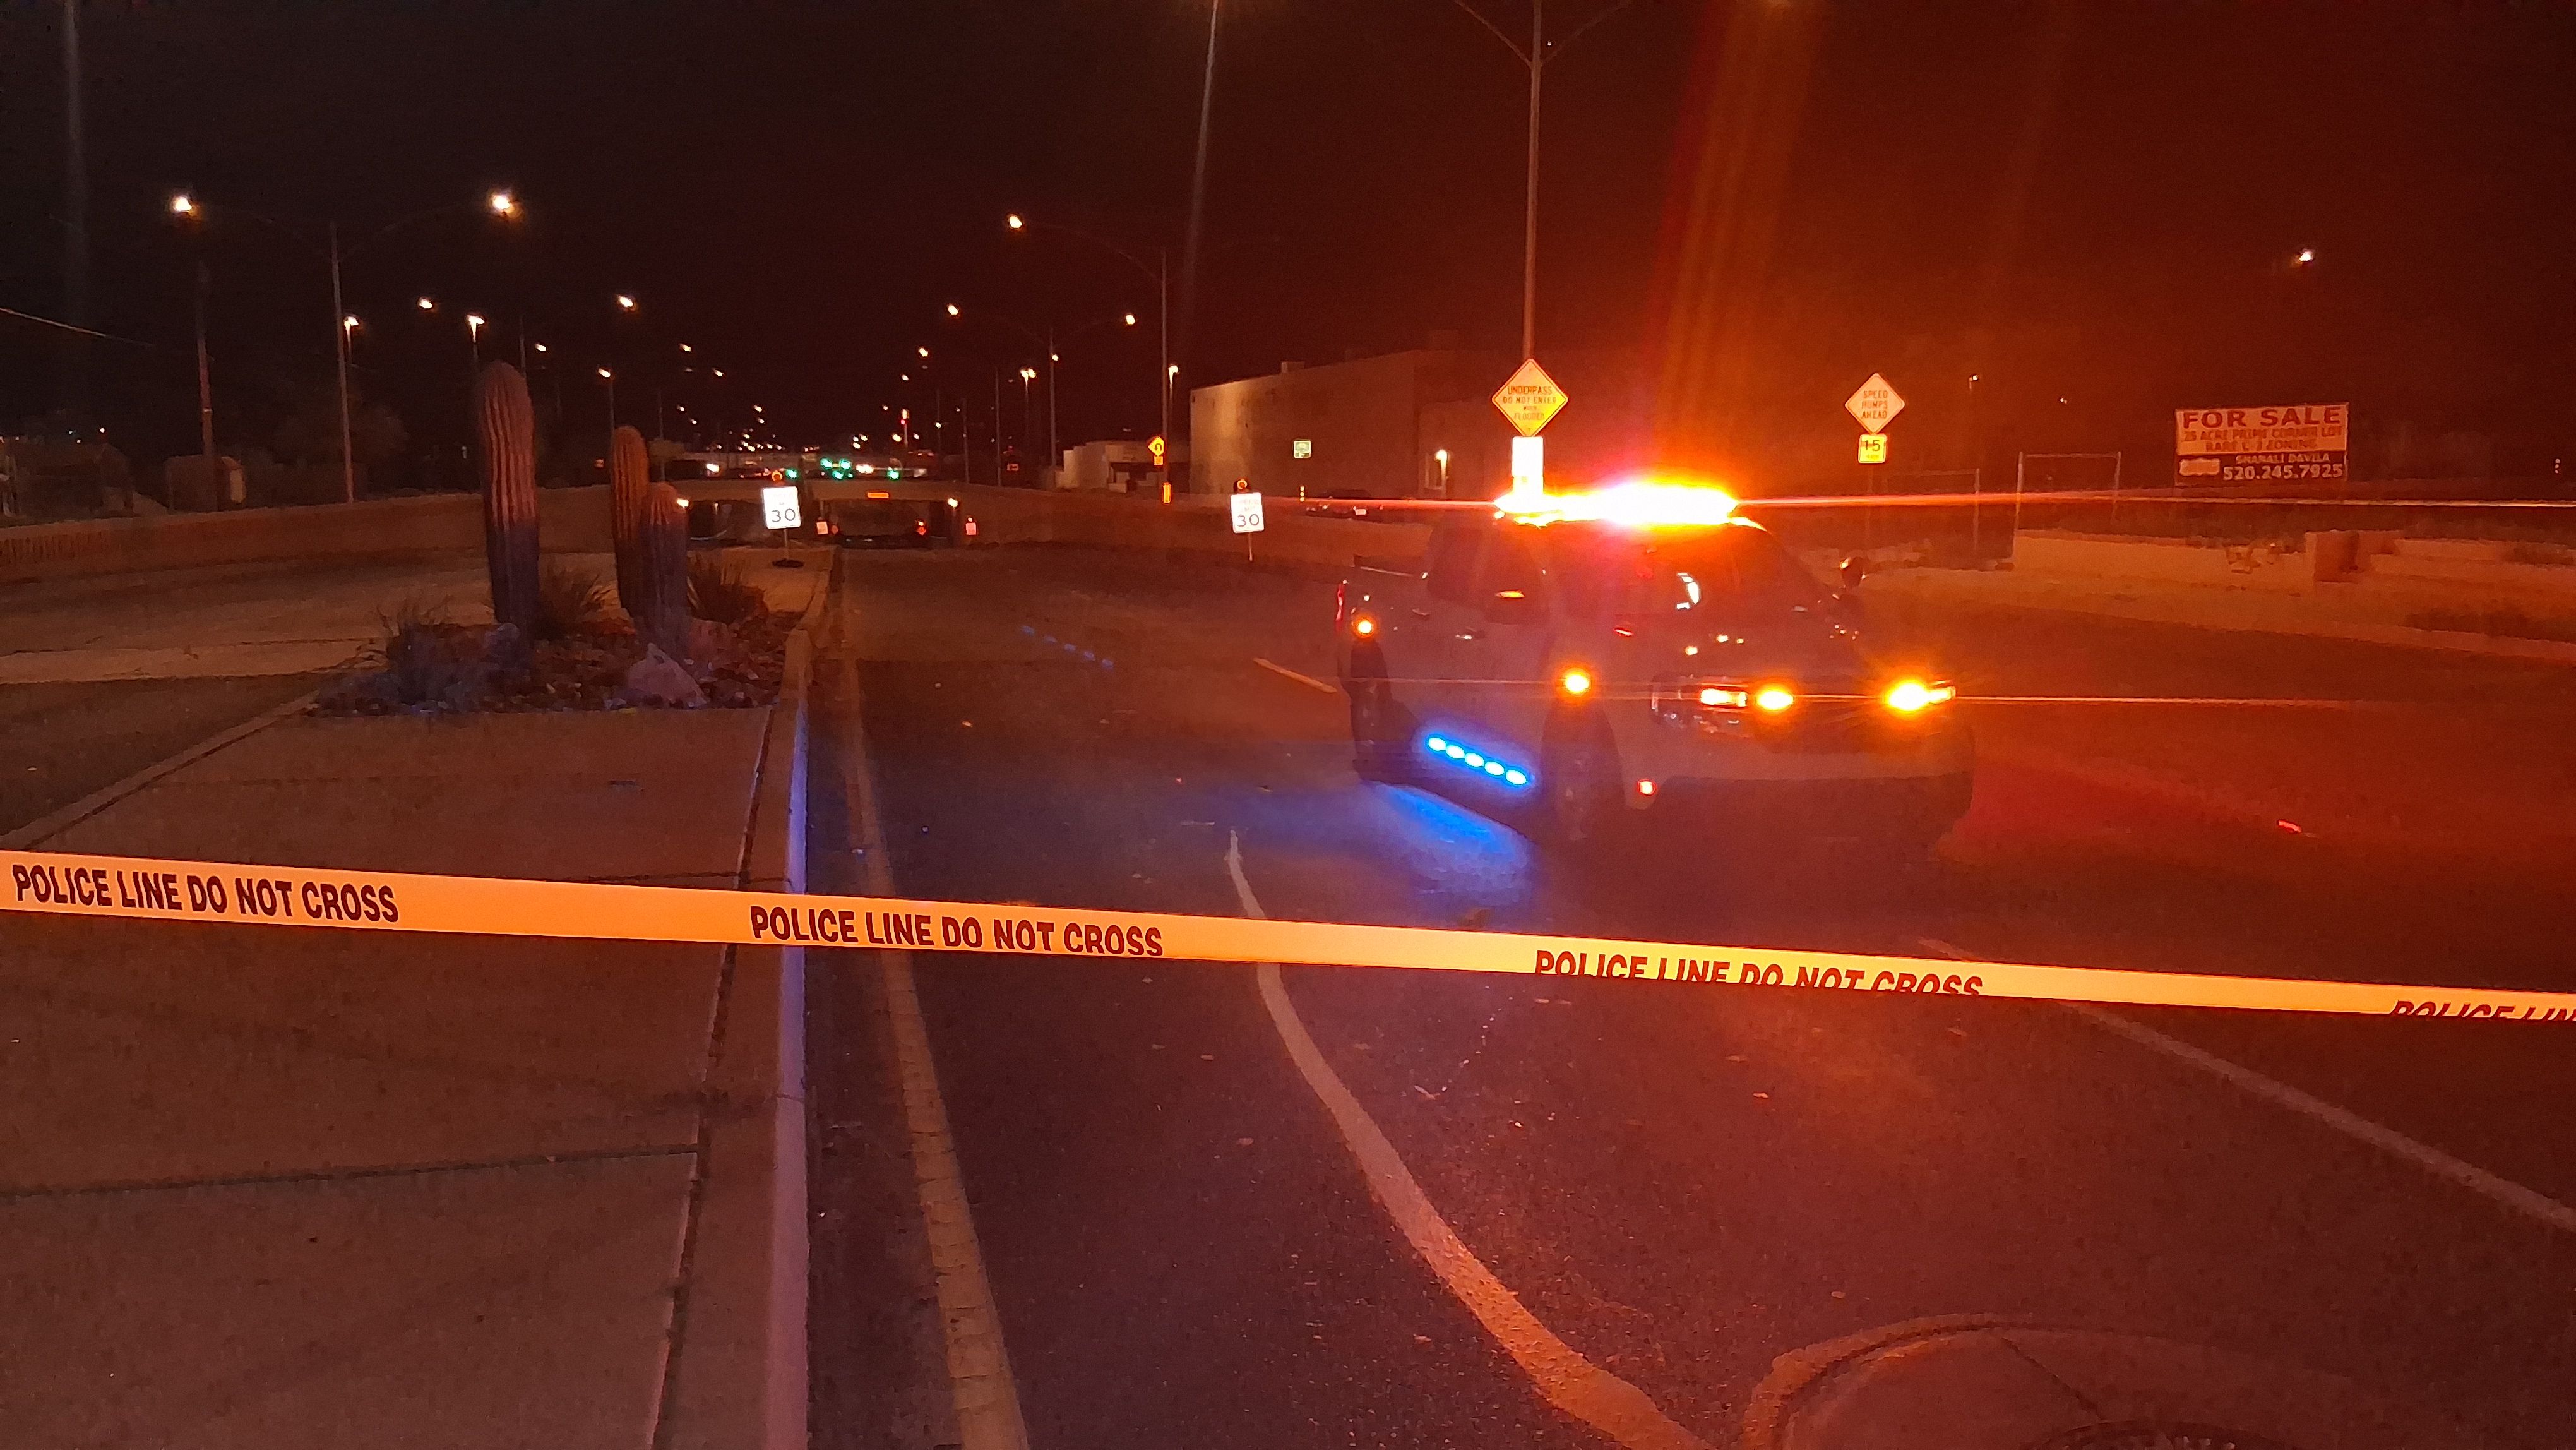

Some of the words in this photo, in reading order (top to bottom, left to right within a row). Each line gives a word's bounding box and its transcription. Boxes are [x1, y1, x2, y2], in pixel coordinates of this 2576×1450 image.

[1507, 385, 1553, 395] UNDERPASS
[1863, 390, 1888, 398] SPEED
[1861, 400, 1888, 409] HUMPS
[1861, 410, 1887, 419] AHEAD
[2183, 410, 2247, 429] FOR
[2260, 406, 2341, 427] SALE
[1864, 439, 1881, 452] 15
[2222, 463, 2343, 481] 520.245.7925
[771, 508, 796, 523] 30
[1237, 513, 1260, 527] 30
[11, 864, 112, 906] POLICE
[116, 870, 182, 911] LINE
[186, 875, 228, 914] DO
[235, 878, 294, 917] NOT
[301, 882, 400, 923] CROSS
[749, 905, 859, 943] POLICE
[866, 911, 935, 947] LINE
[941, 916, 983, 949] DO
[993, 918, 1054, 952] NOT
[1063, 921, 1164, 957] CROSS
[1535, 950, 1648, 978] POLICE
[1657, 957, 1731, 982] LINE
[1739, 962, 1784, 986] DO
[1796, 966, 1866, 989] NOT
[1871, 970, 1983, 996] CROSS
